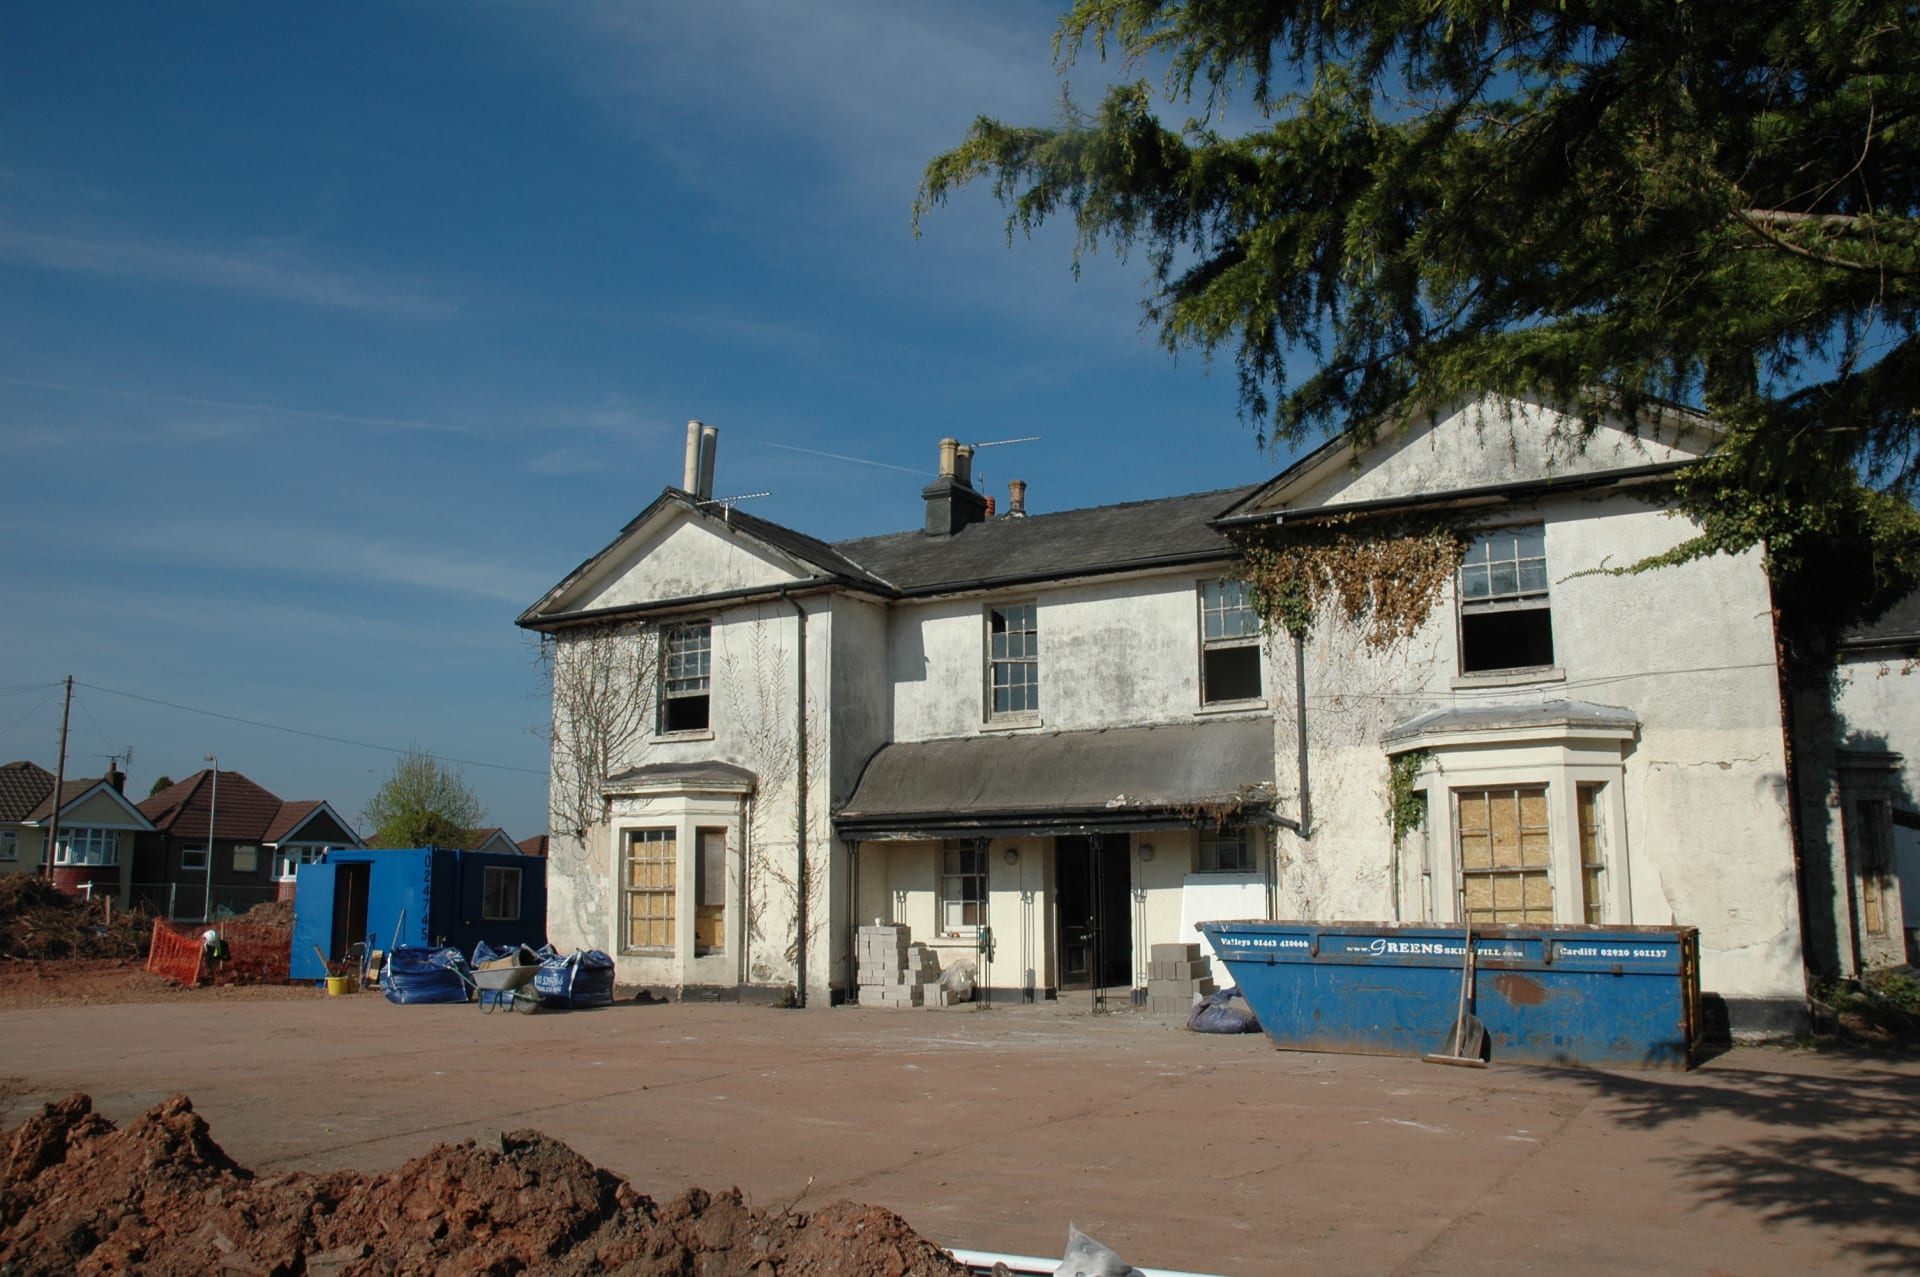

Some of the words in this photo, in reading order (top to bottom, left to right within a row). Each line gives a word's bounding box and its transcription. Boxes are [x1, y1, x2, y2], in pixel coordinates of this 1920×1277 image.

[1220, 937, 1251, 947] Valleys
[1253, 939, 1277, 947] 01443
[1559, 947, 1597, 956] Cardiff
[1600, 948, 1630, 957] 02920
[1633, 949, 1667, 958] 501137
